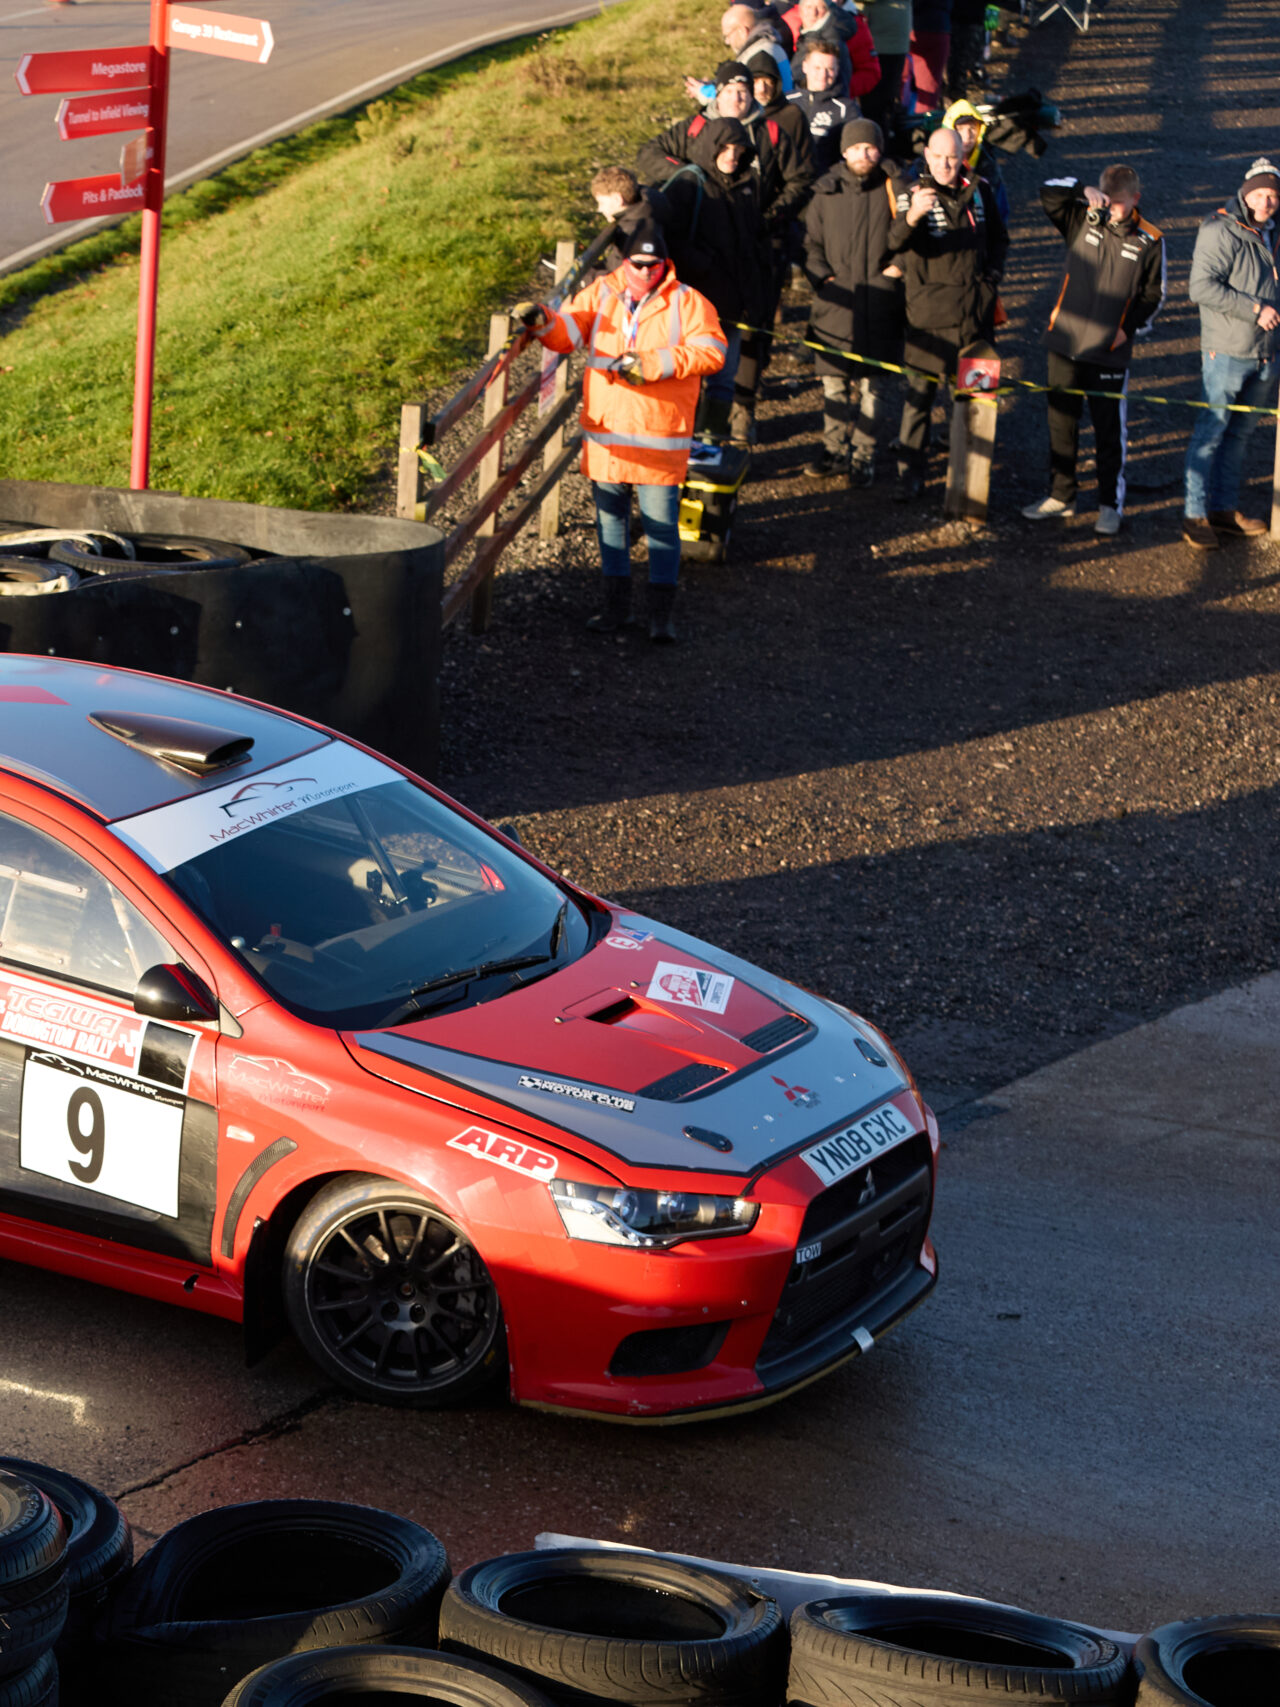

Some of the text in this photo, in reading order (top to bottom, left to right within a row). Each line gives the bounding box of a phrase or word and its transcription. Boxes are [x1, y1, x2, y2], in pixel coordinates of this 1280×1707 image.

[91, 62, 146, 77] Megastore
[68, 102, 149, 124] Tunnel to Infield Viewing
[82, 191, 98, 204] Pits
[108, 184, 143, 200] Paddock
[209, 799, 297, 842] MacWhirter
[7, 987, 122, 1038] TEGIWA
[1, 1011, 118, 1059] DONINGTON RALLY
[86, 1066, 158, 1095] MacWhirter
[228, 1069, 328, 1104] MacWhirter
[541, 1083, 634, 1111] MOTOR CLUB
[67, 1086, 105, 1184] 9
[454, 1131, 555, 1174] ARP
[810, 1109, 907, 1176] YN08 GXC
[799, 1244, 821, 1263] TOW
